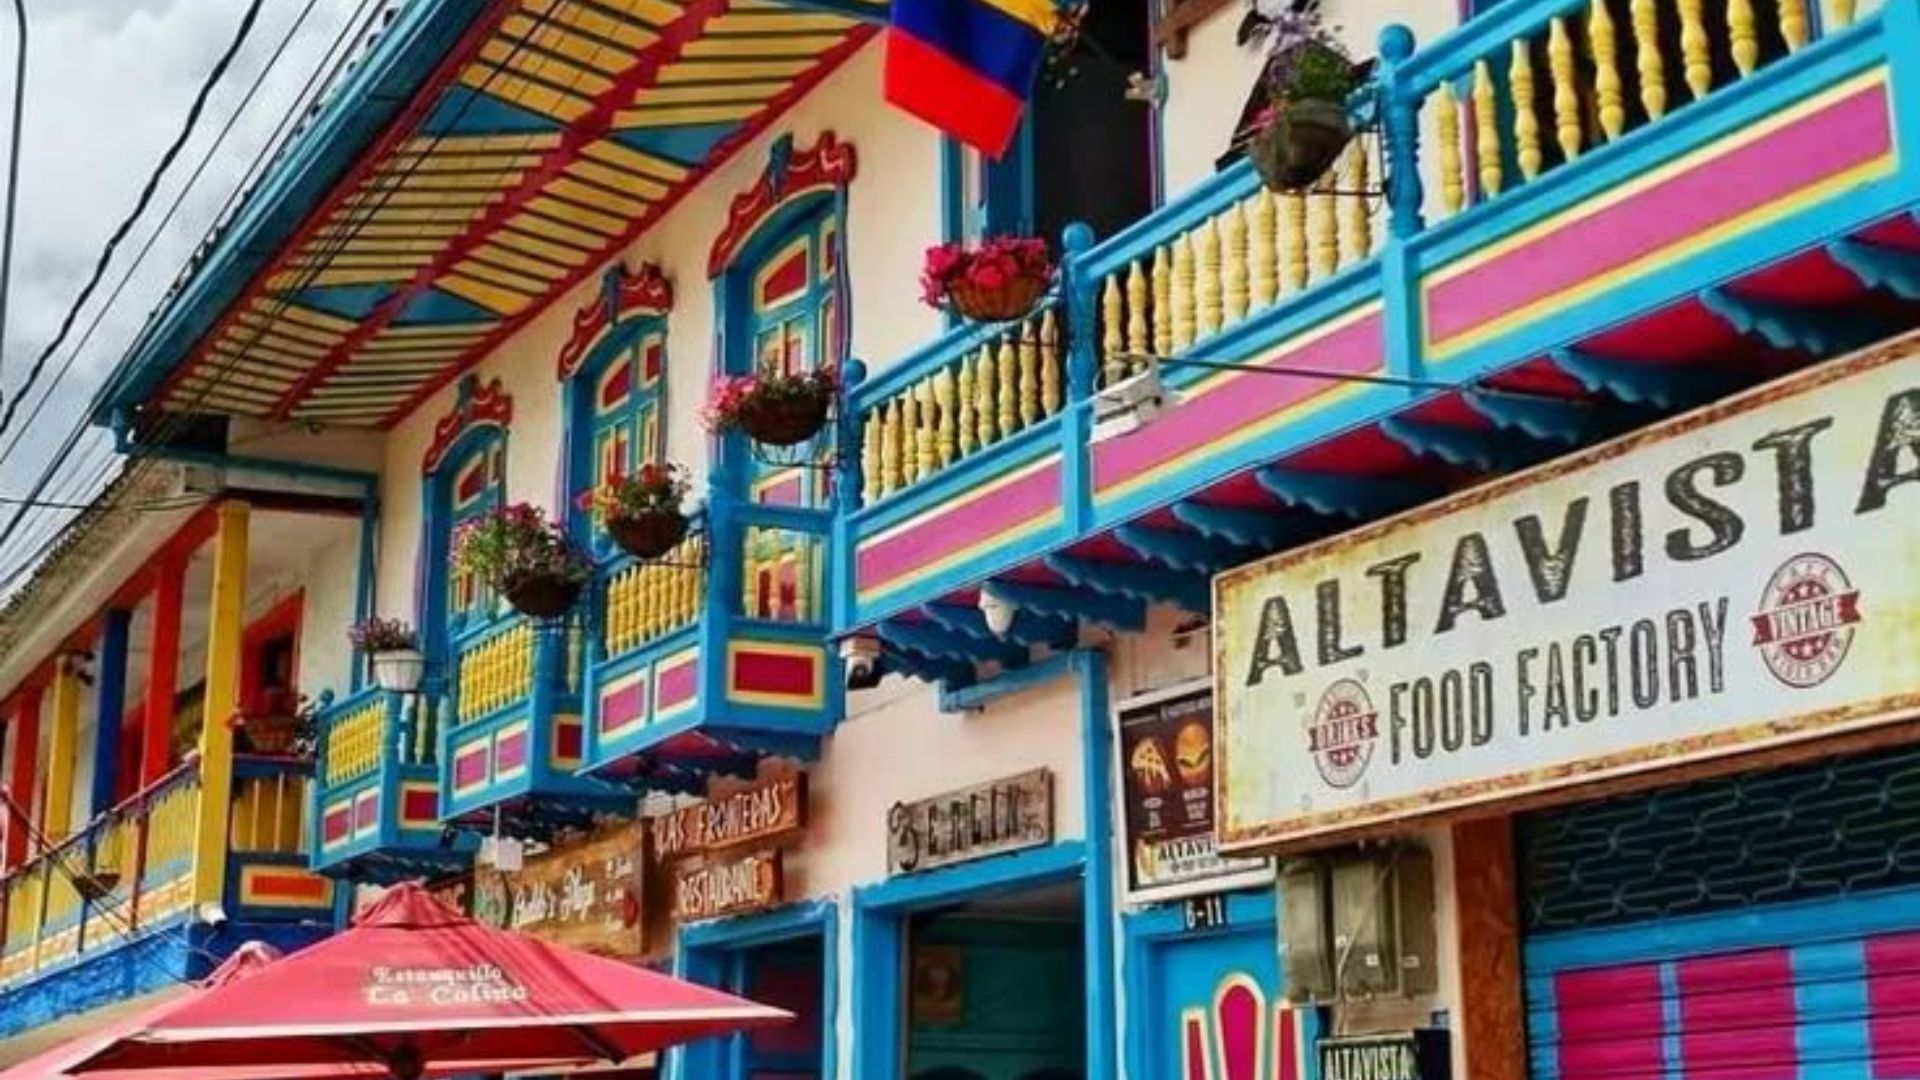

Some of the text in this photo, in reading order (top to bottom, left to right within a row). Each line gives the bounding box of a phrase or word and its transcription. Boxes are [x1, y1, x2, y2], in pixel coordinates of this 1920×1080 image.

[1245, 388, 1920, 686] ALTAVISTA
[1389, 596, 1730, 764] FOOD FACTORY
[1185, 896, 1223, 930] 6-11
[366, 986, 410, 1006] La
[1324, 1043, 1413, 1080] ALTAVISTA
